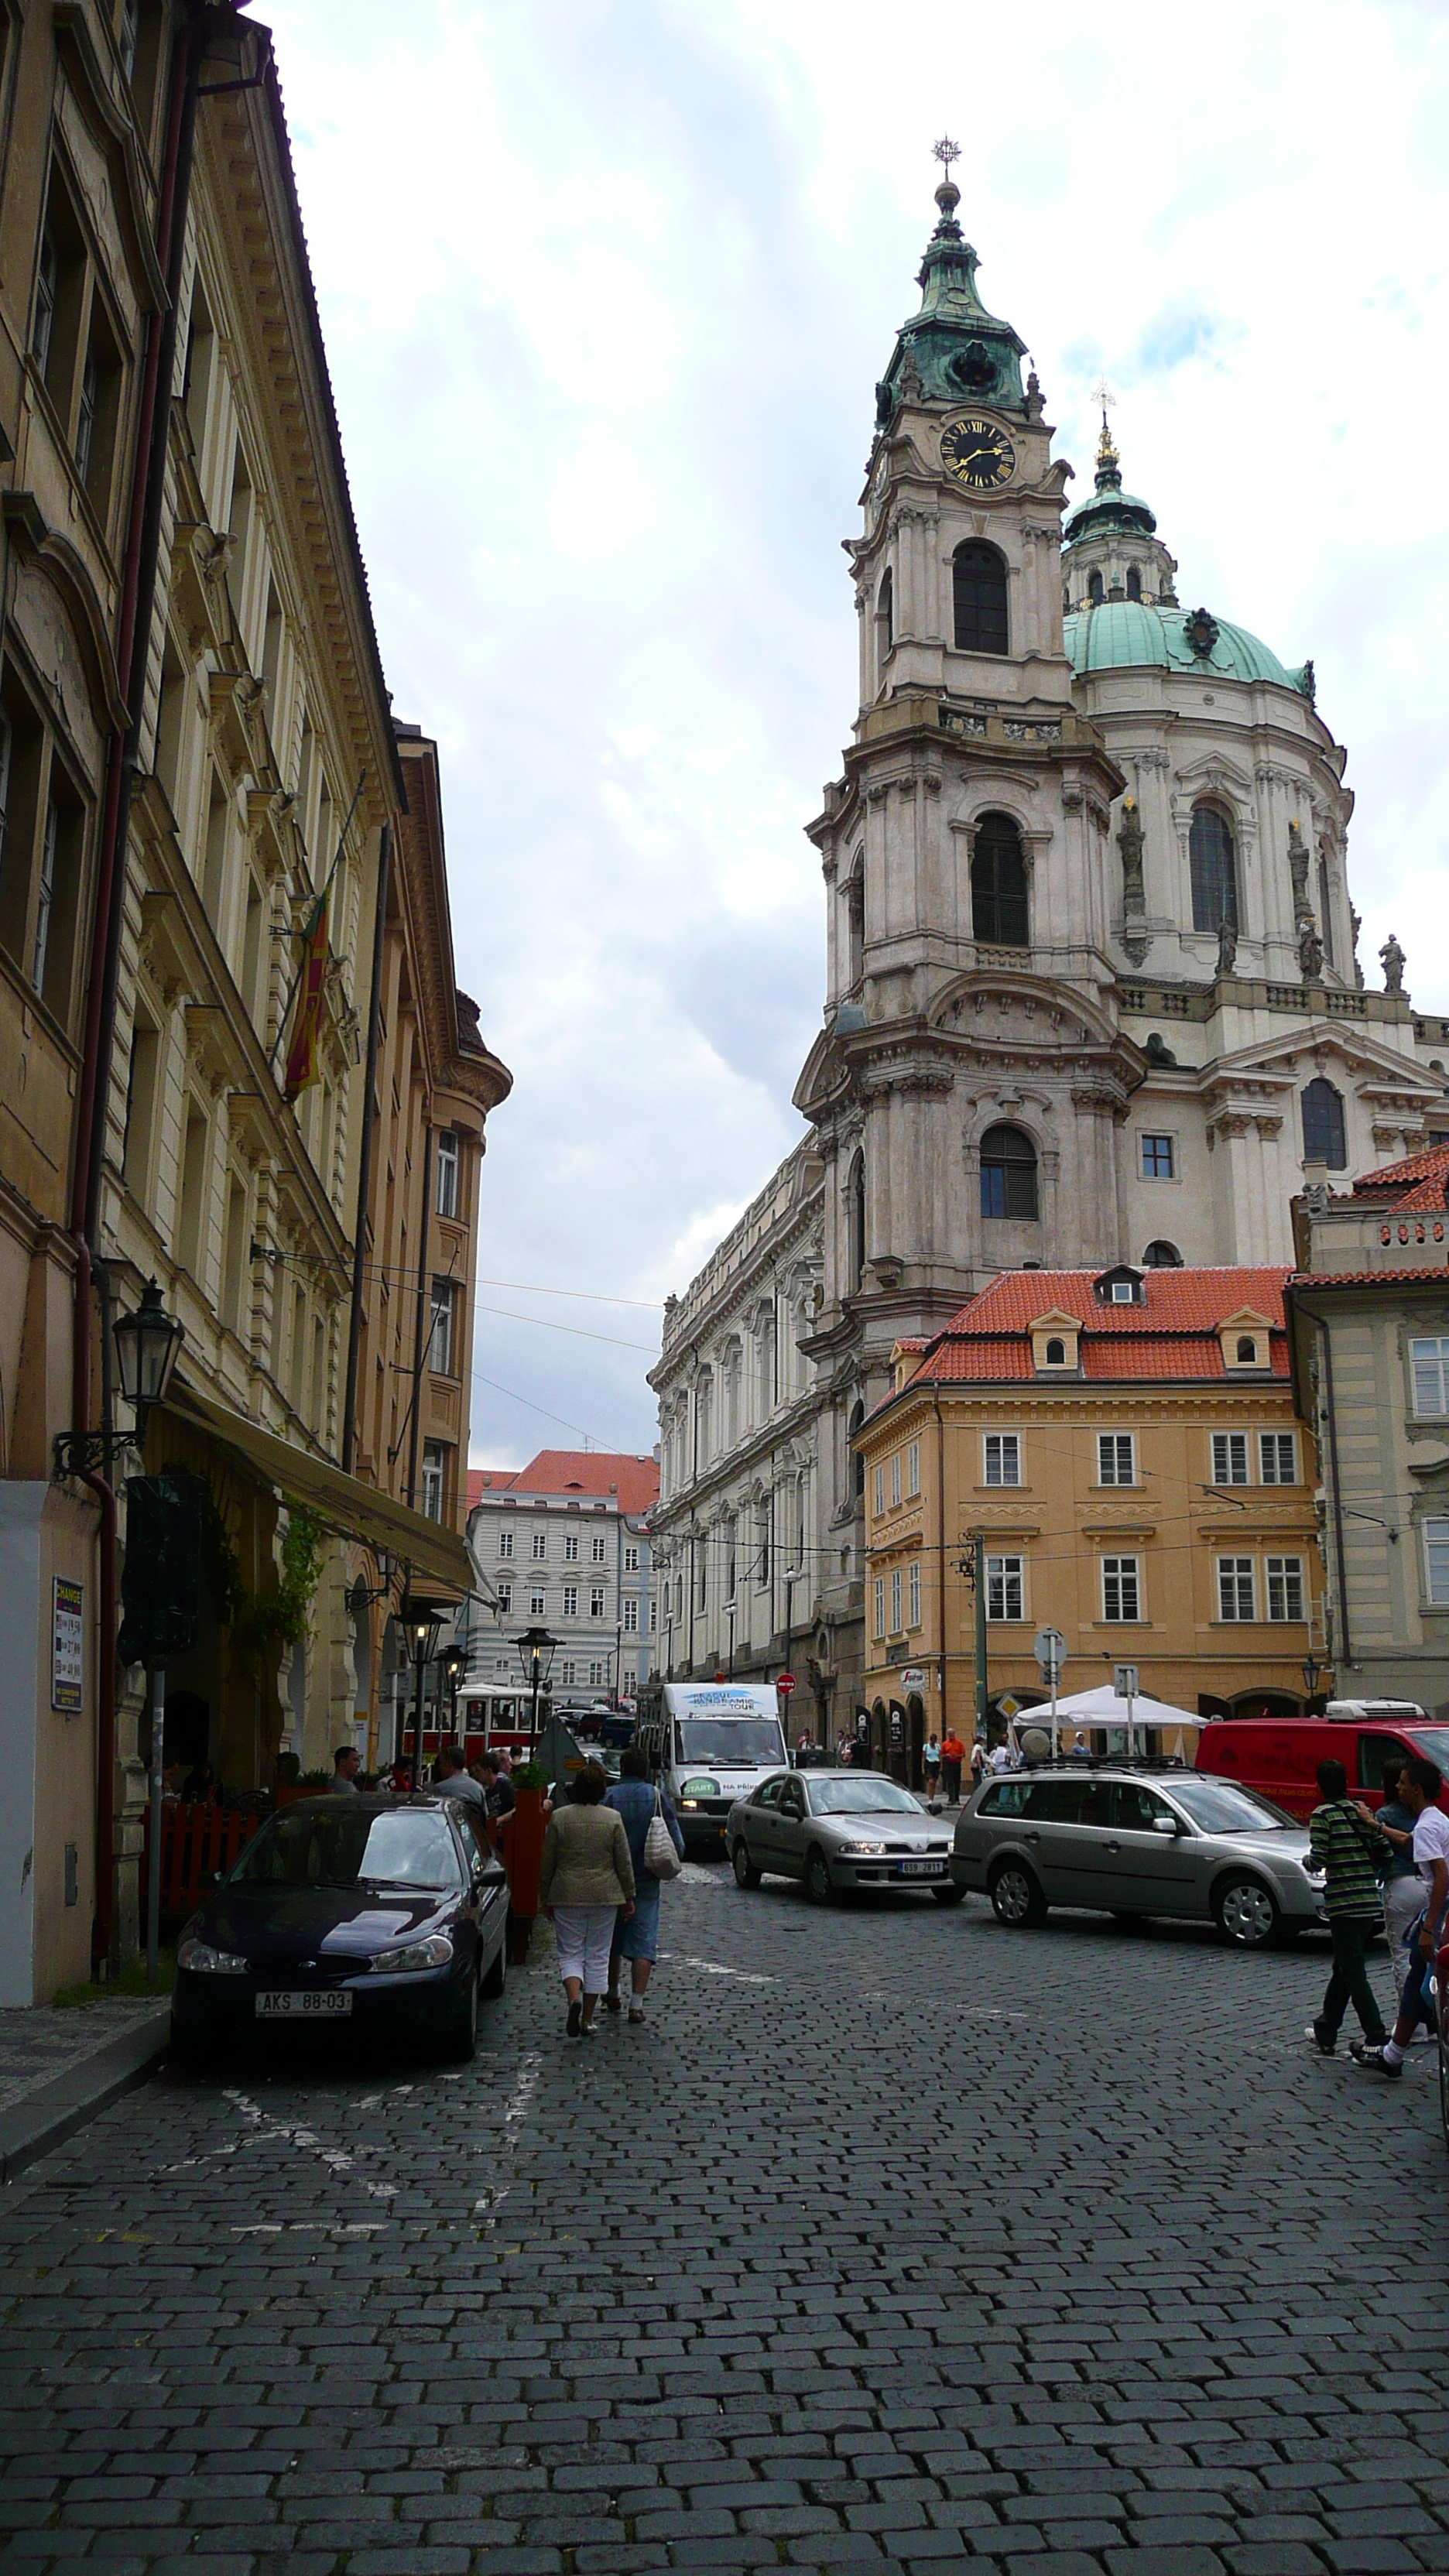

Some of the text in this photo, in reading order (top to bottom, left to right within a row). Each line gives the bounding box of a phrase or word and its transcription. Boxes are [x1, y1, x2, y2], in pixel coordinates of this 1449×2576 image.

[955, 421, 968, 436] XI
[971, 420, 983, 434] XII
[988, 426, 996, 438] I
[996, 439, 1010, 448] II
[1001, 454, 1015, 463] III
[975, 474, 984, 488] VI
[990, 474, 1000, 487] V
[57, 1584, 81, 1605] CHANGE
[684, 1783, 712, 1794] START
[904, 1863, 918, 1872] 6S9
[263, 1993, 345, 2010] AKS 88-03
